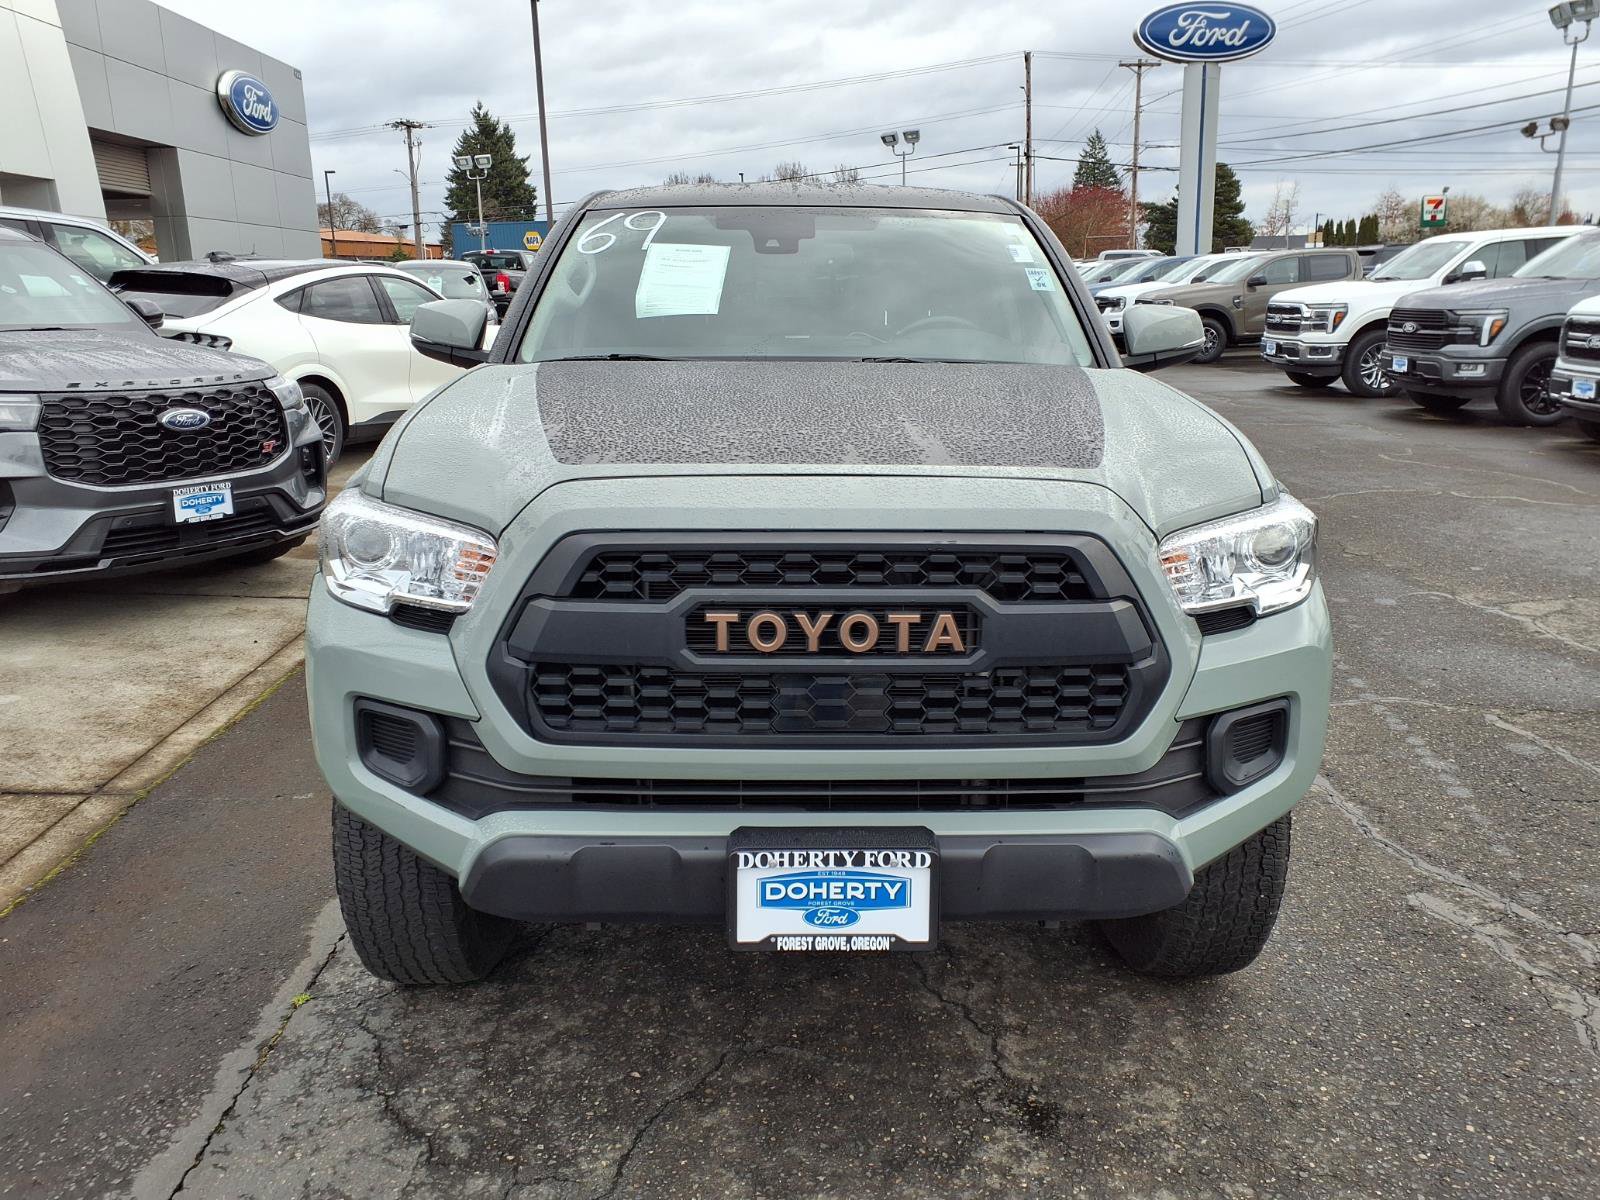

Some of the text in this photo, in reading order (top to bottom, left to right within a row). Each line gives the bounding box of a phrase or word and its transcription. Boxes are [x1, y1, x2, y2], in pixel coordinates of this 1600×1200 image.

[1168, 10, 1251, 47] Ford
[243, 84, 273, 123] Ford
[577, 210, 668, 255] 69
[66, 374, 243, 389] EXPLORER
[174, 413, 202, 427] Ford
[173, 482, 232, 496] DOHERTY FORD
[181, 495, 223, 507] DOHERTY
[705, 611, 966, 653] TOYOTA
[737, 850, 931, 869] DOHERTY FORD
[765, 882, 902, 901] DOHERTY
[814, 908, 849, 926] Ford
[777, 936, 890, 952] FOREST GROVE, OREGON
